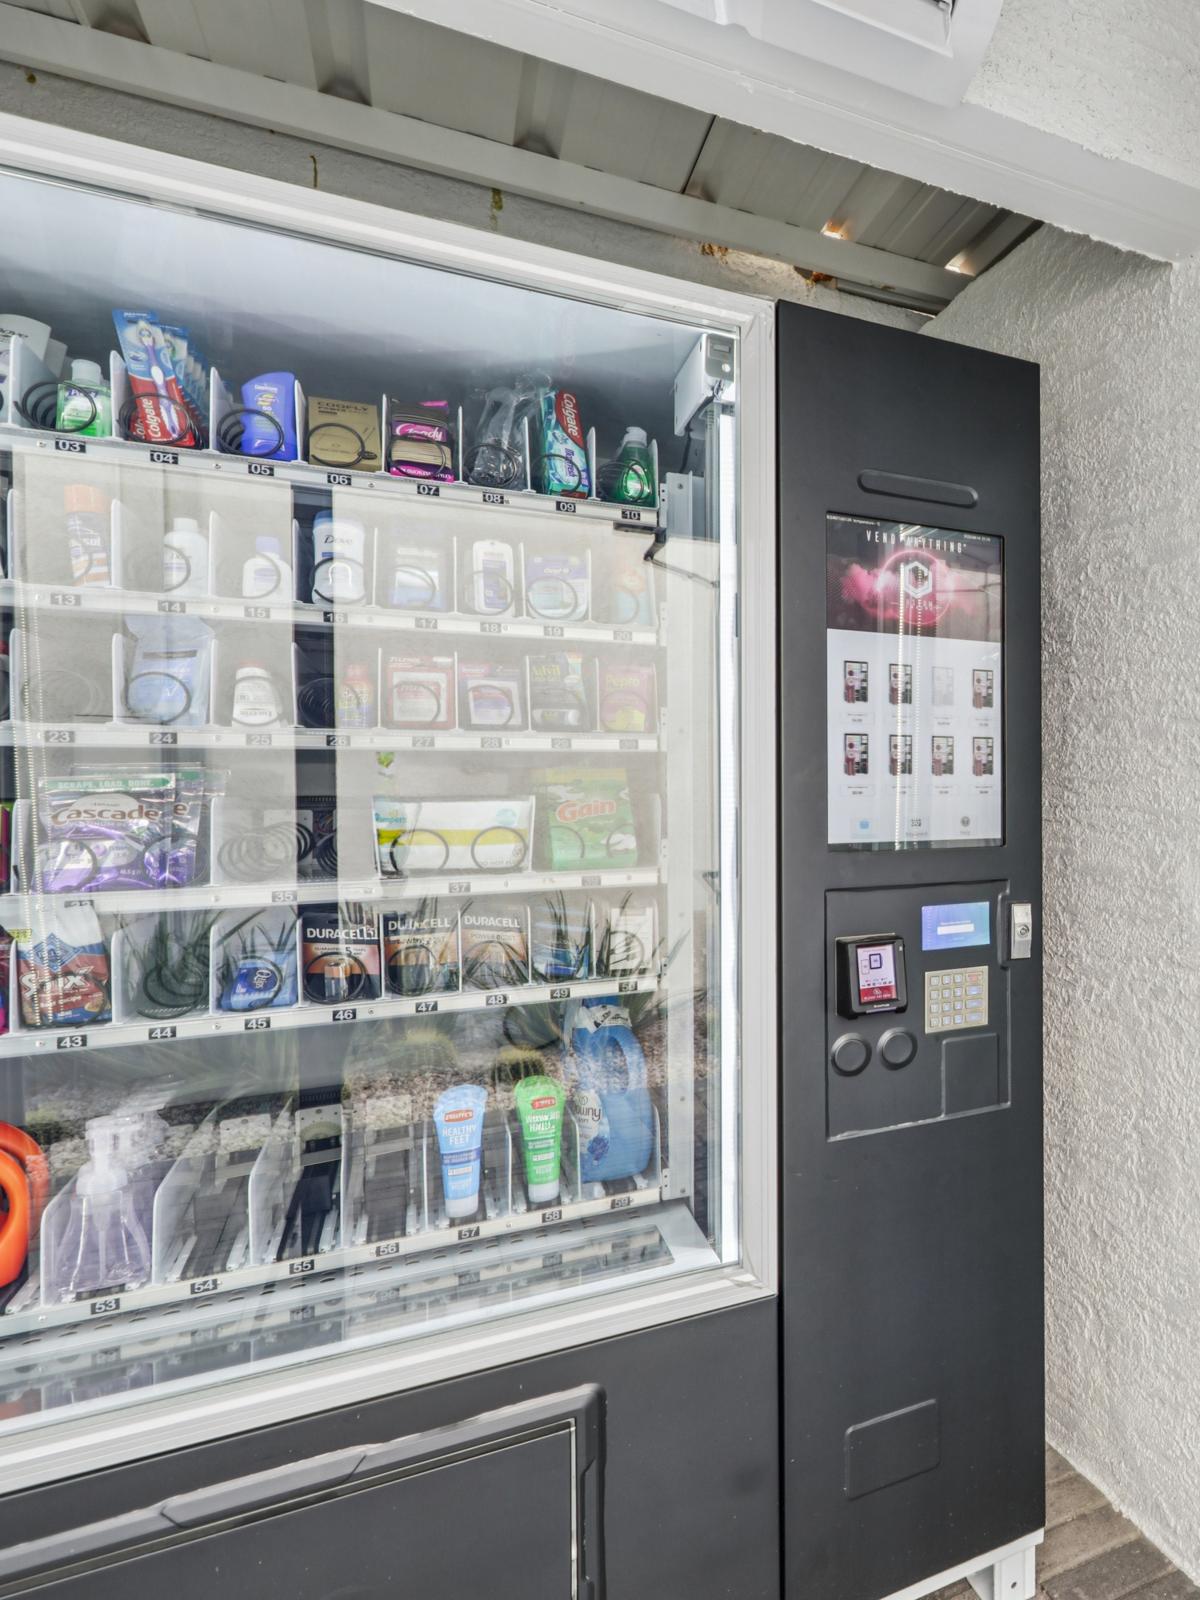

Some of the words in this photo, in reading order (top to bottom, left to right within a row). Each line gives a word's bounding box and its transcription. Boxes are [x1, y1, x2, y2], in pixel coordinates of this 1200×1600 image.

[563, 393, 579, 437] Colgate
[58, 440, 82, 452] 03
[153, 452, 175, 464] 04
[251, 464, 271, 475] 05
[330, 474, 348, 484] 06
[420, 484, 436, 495] 07
[486, 492, 501, 504] 08
[560, 502, 575, 512] 09
[624, 510, 639, 520] 10
[866, 530, 896, 545] VEND
[54, 595, 76, 606] 13
[162, 602, 182, 613] 14
[249, 608, 266, 618] 15
[48, 730, 71, 744] 23
[152, 732, 174, 744] 24
[251, 734, 271, 745] 25
[52, 803, 160, 826] Cascade
[556, 800, 616, 823] Gain
[274, 892, 294, 902] 35
[464, 916, 520, 928] DURACELL
[554, 988, 568, 998] 49
[488, 996, 504, 1006] 48
[418, 1002, 434, 1012] 47
[334, 1009, 354, 1020] 46
[247, 1018, 267, 1029] 45
[152, 1028, 173, 1039] 44
[60, 1037, 83, 1048] 43
[442, 1124, 476, 1136] HEALTHY
[450, 1134, 470, 1145] FEET
[615, 1198, 630, 1208] 59
[545, 1212, 560, 1221] 58
[461, 1228, 477, 1238] 57
[379, 1244, 397, 1254] 56
[292, 1262, 311, 1272] 55
[194, 1282, 214, 1292] 54
[95, 1300, 116, 1312] 53
